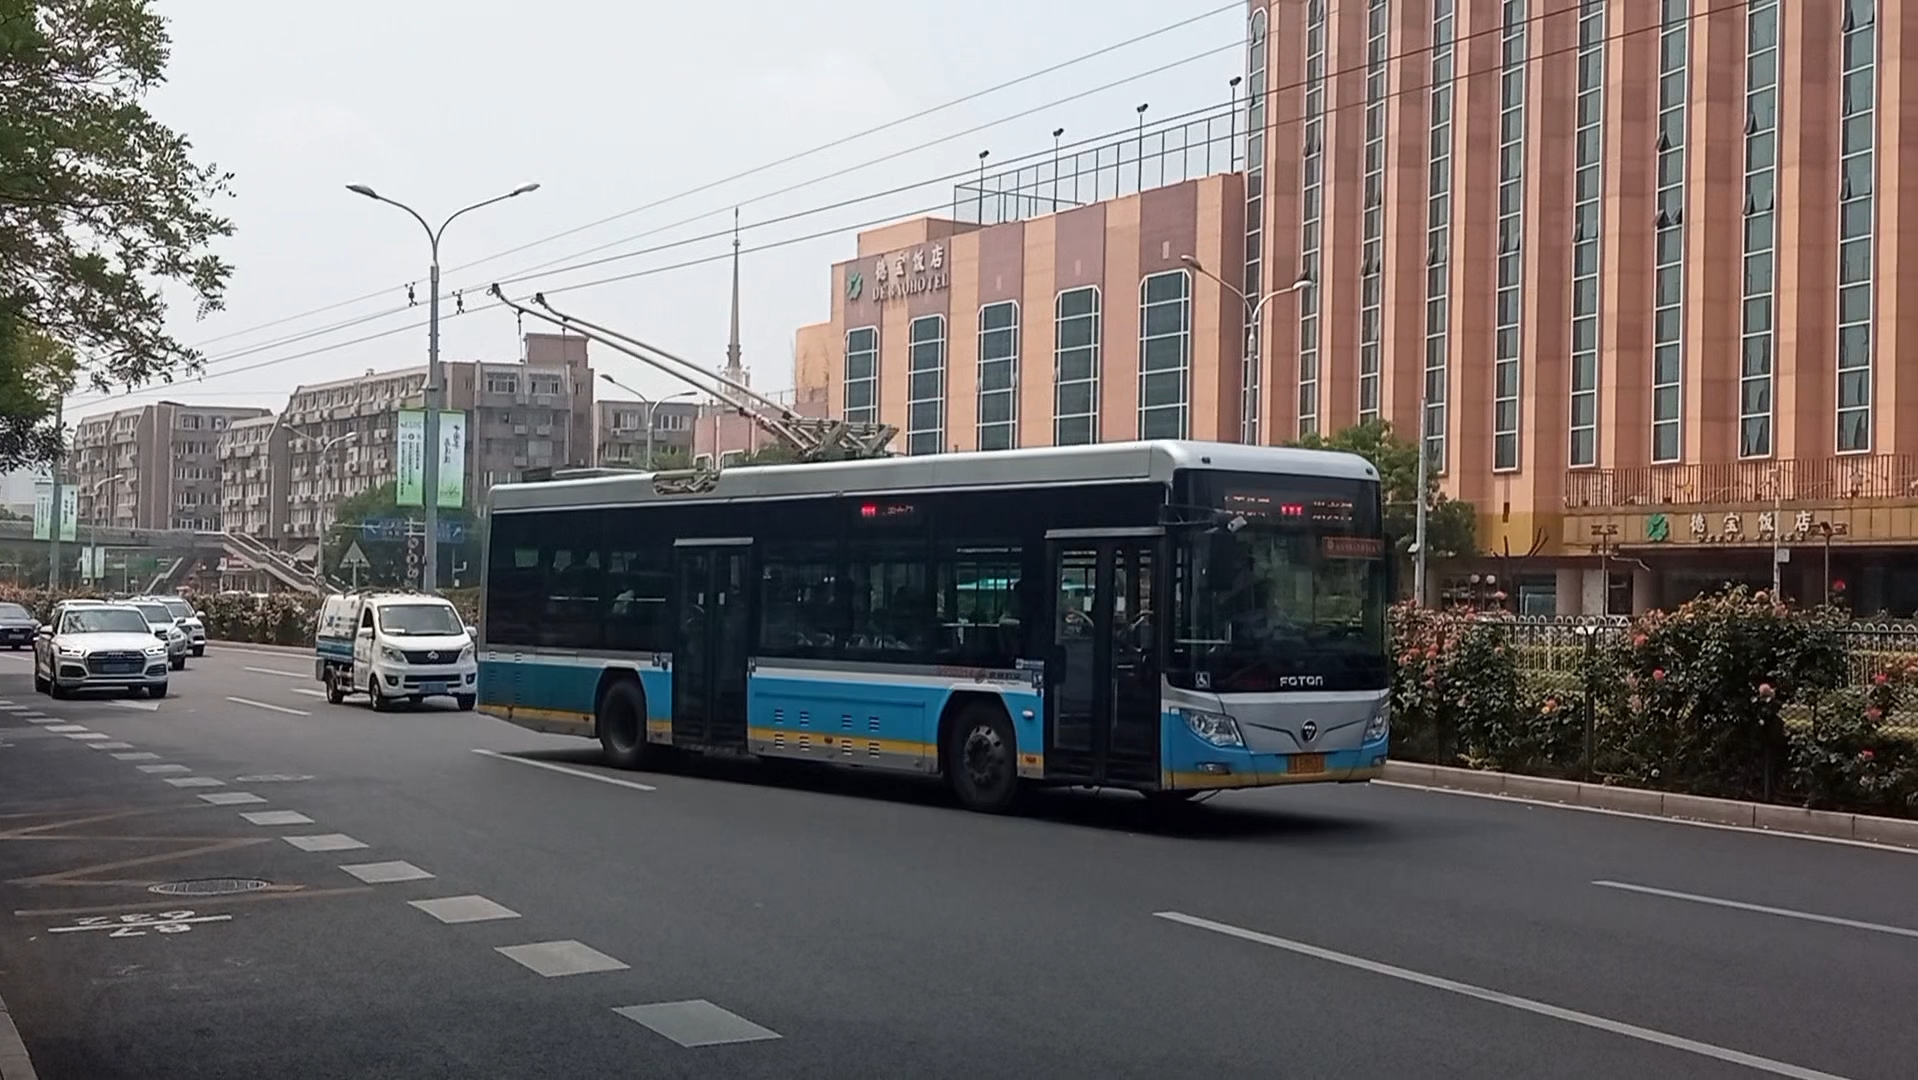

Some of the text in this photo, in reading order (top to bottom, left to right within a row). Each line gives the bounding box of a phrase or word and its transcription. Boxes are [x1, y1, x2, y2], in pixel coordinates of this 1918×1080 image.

[1690, 511, 1811, 532] 德宝饭店
[1280, 675, 1323, 687] FOTON
